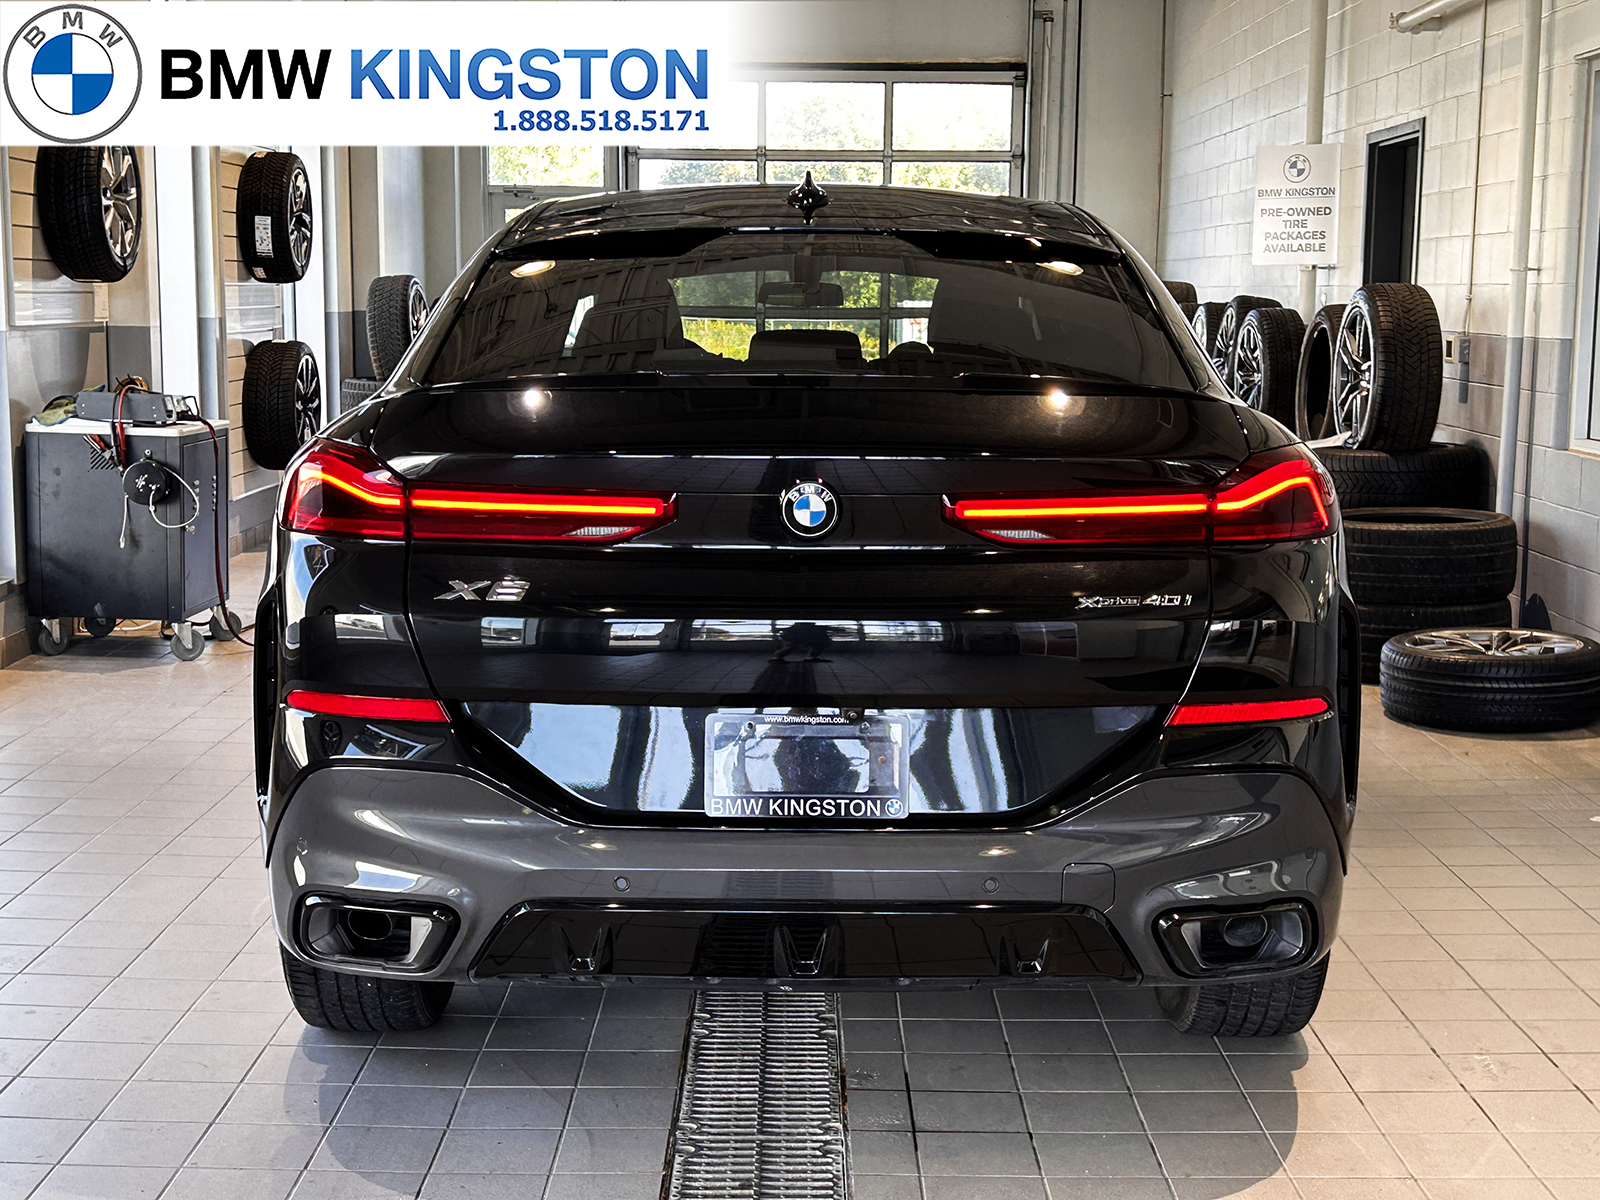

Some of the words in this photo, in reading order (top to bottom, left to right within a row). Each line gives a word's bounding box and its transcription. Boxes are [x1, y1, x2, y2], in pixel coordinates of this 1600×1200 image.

[1257, 188, 1283, 198] BMW
[1285, 186, 1336, 197] KINGSTON
[1260, 206, 1332, 217] PRE-OWNED
[1282, 219, 1308, 229] TIRE
[1264, 230, 1327, 241] PACKAGES
[1263, 242, 1327, 253] AVAILABLE
[788, 485, 833, 503] BMW
[710, 798, 763, 815] BMW
[768, 799, 881, 817] KINGSTON
